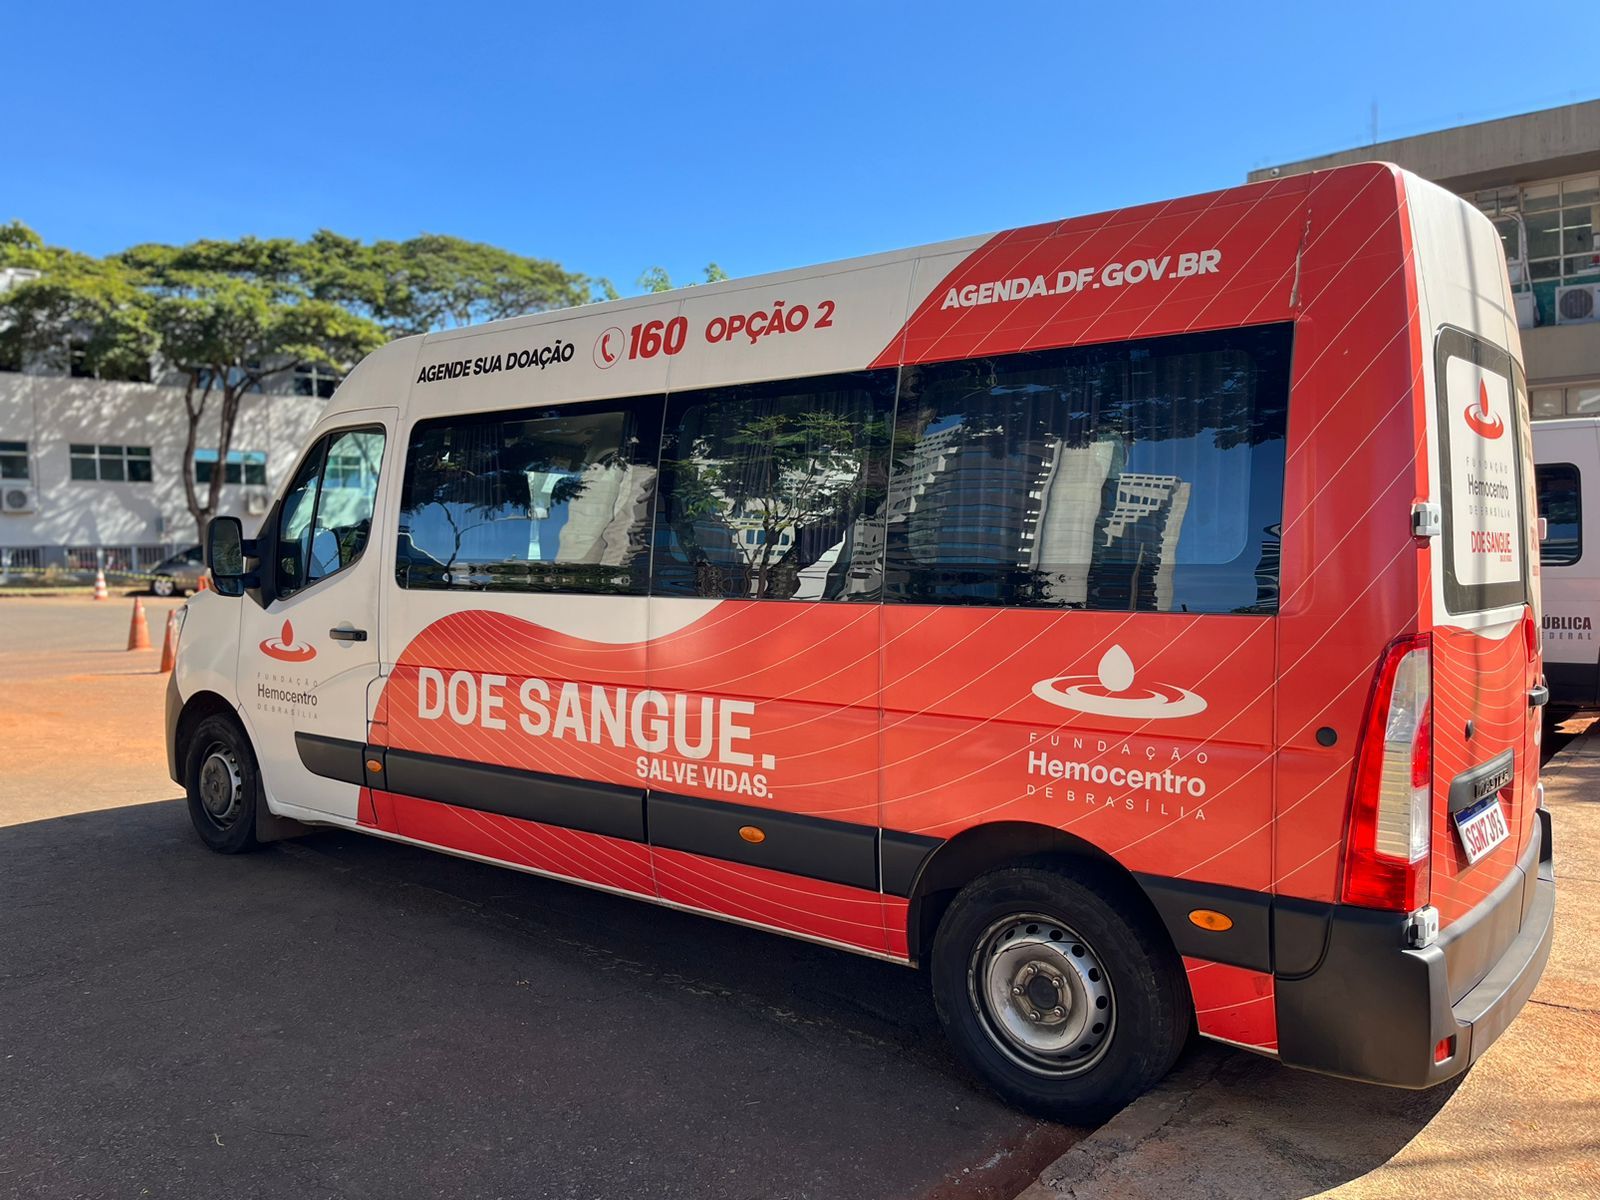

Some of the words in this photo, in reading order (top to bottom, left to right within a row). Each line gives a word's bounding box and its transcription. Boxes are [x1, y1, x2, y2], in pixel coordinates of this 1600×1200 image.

[940, 249, 1222, 311] AGENDA.DF.GOV.BR
[628, 315, 689, 360] 160
[704, 300, 809, 345] OPÇÃO
[813, 299, 836, 329] 2
[416, 355, 471, 384] AGENDE
[473, 351, 502, 376] SUA
[504, 339, 575, 372] DOAÇÃO
[1467, 473, 1509, 500] Hemocentro
[1471, 530, 1486, 553] DOE
[257, 683, 318, 706] Hemocentro
[418, 667, 507, 731] DOE
[519, 677, 775, 770] SANGUE.
[1029, 732, 1208, 764] FUNDAÇÃO
[636, 755, 698, 786] SALVE
[703, 765, 774, 799] VIDAS.
[1027, 750, 1206, 797] Hemocentro
